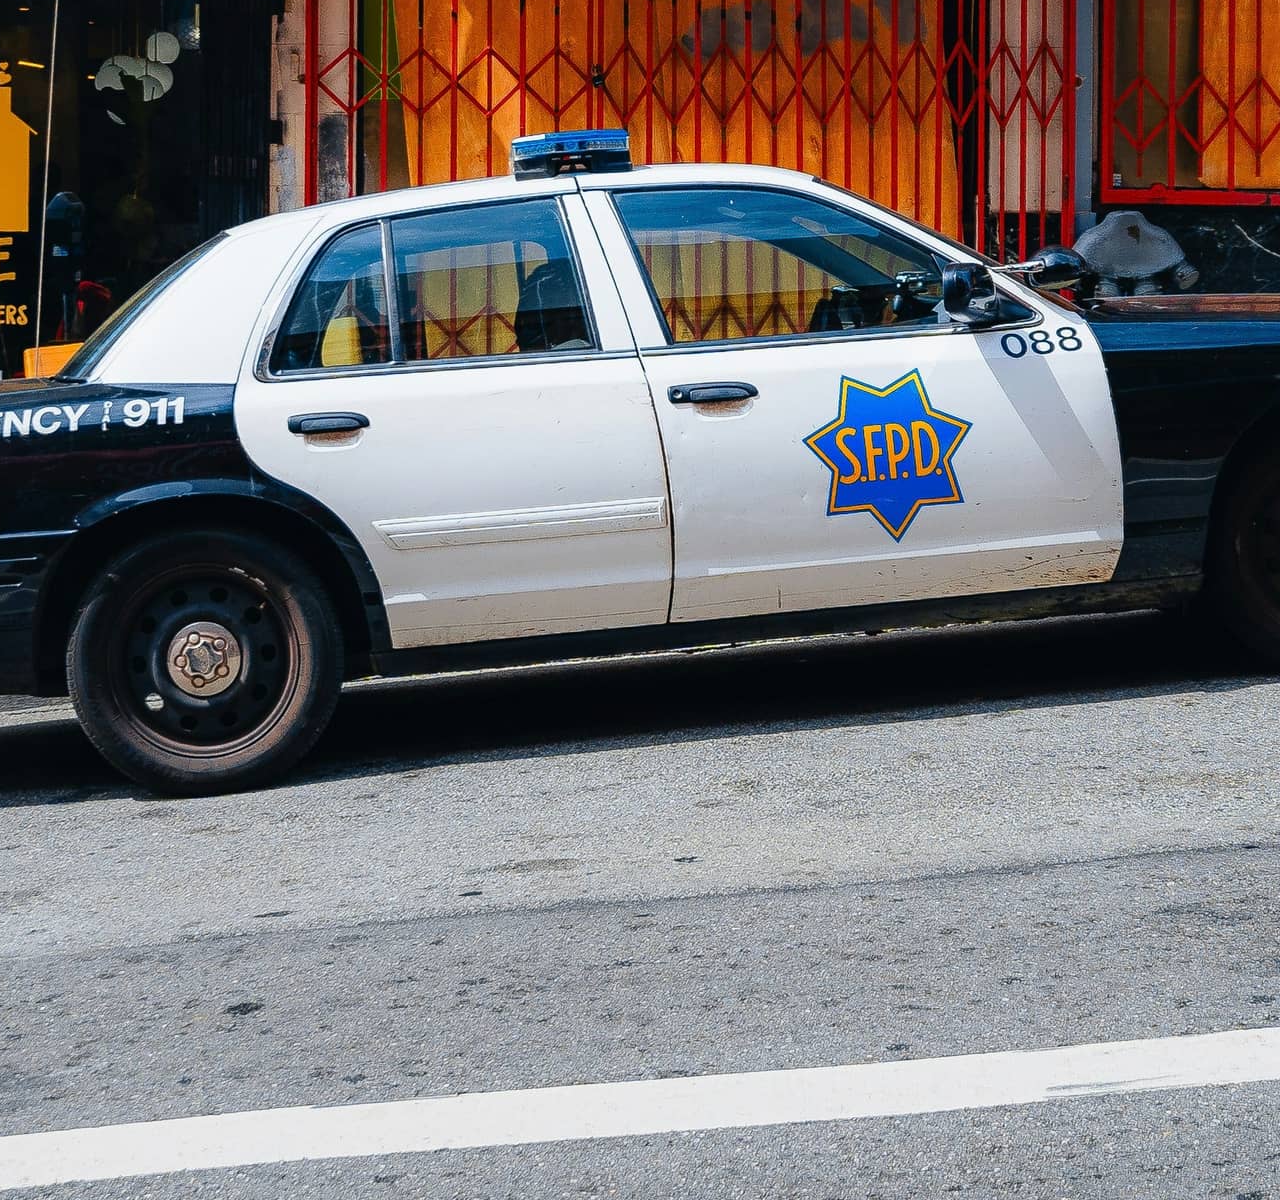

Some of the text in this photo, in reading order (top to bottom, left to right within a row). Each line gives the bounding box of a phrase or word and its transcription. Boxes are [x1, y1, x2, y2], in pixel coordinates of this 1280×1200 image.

[1000, 326, 1083, 359] 088
[101, 401, 113, 431] DIAL
[123, 396, 185, 427] 911
[835, 420, 944, 485] S.F.P.D.
